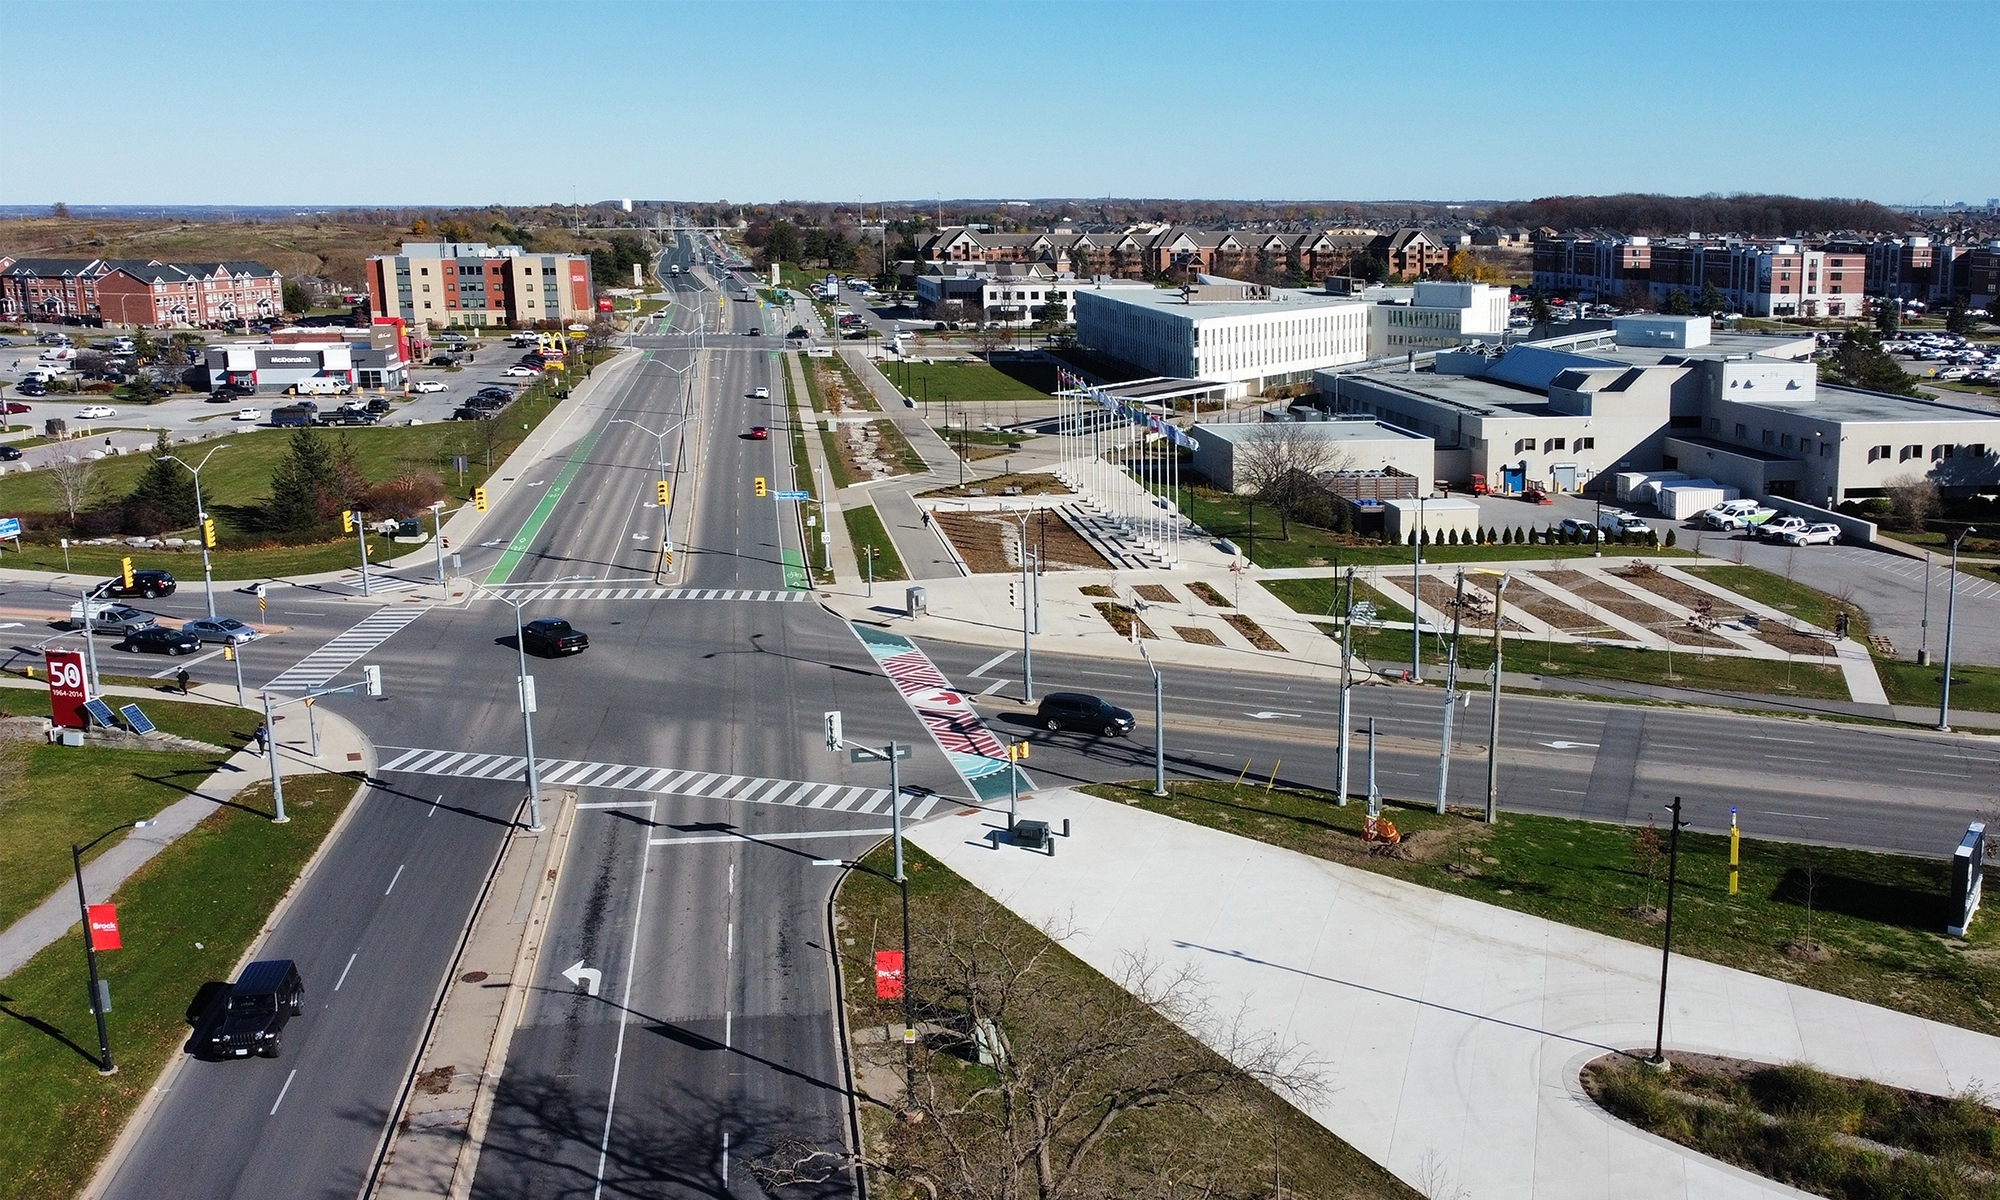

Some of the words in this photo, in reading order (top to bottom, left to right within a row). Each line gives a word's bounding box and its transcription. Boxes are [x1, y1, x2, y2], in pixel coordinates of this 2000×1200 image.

[50, 661, 81, 688] 50
[52, 689, 83, 698] 1964-2014
[92, 922, 116, 930] Brock
